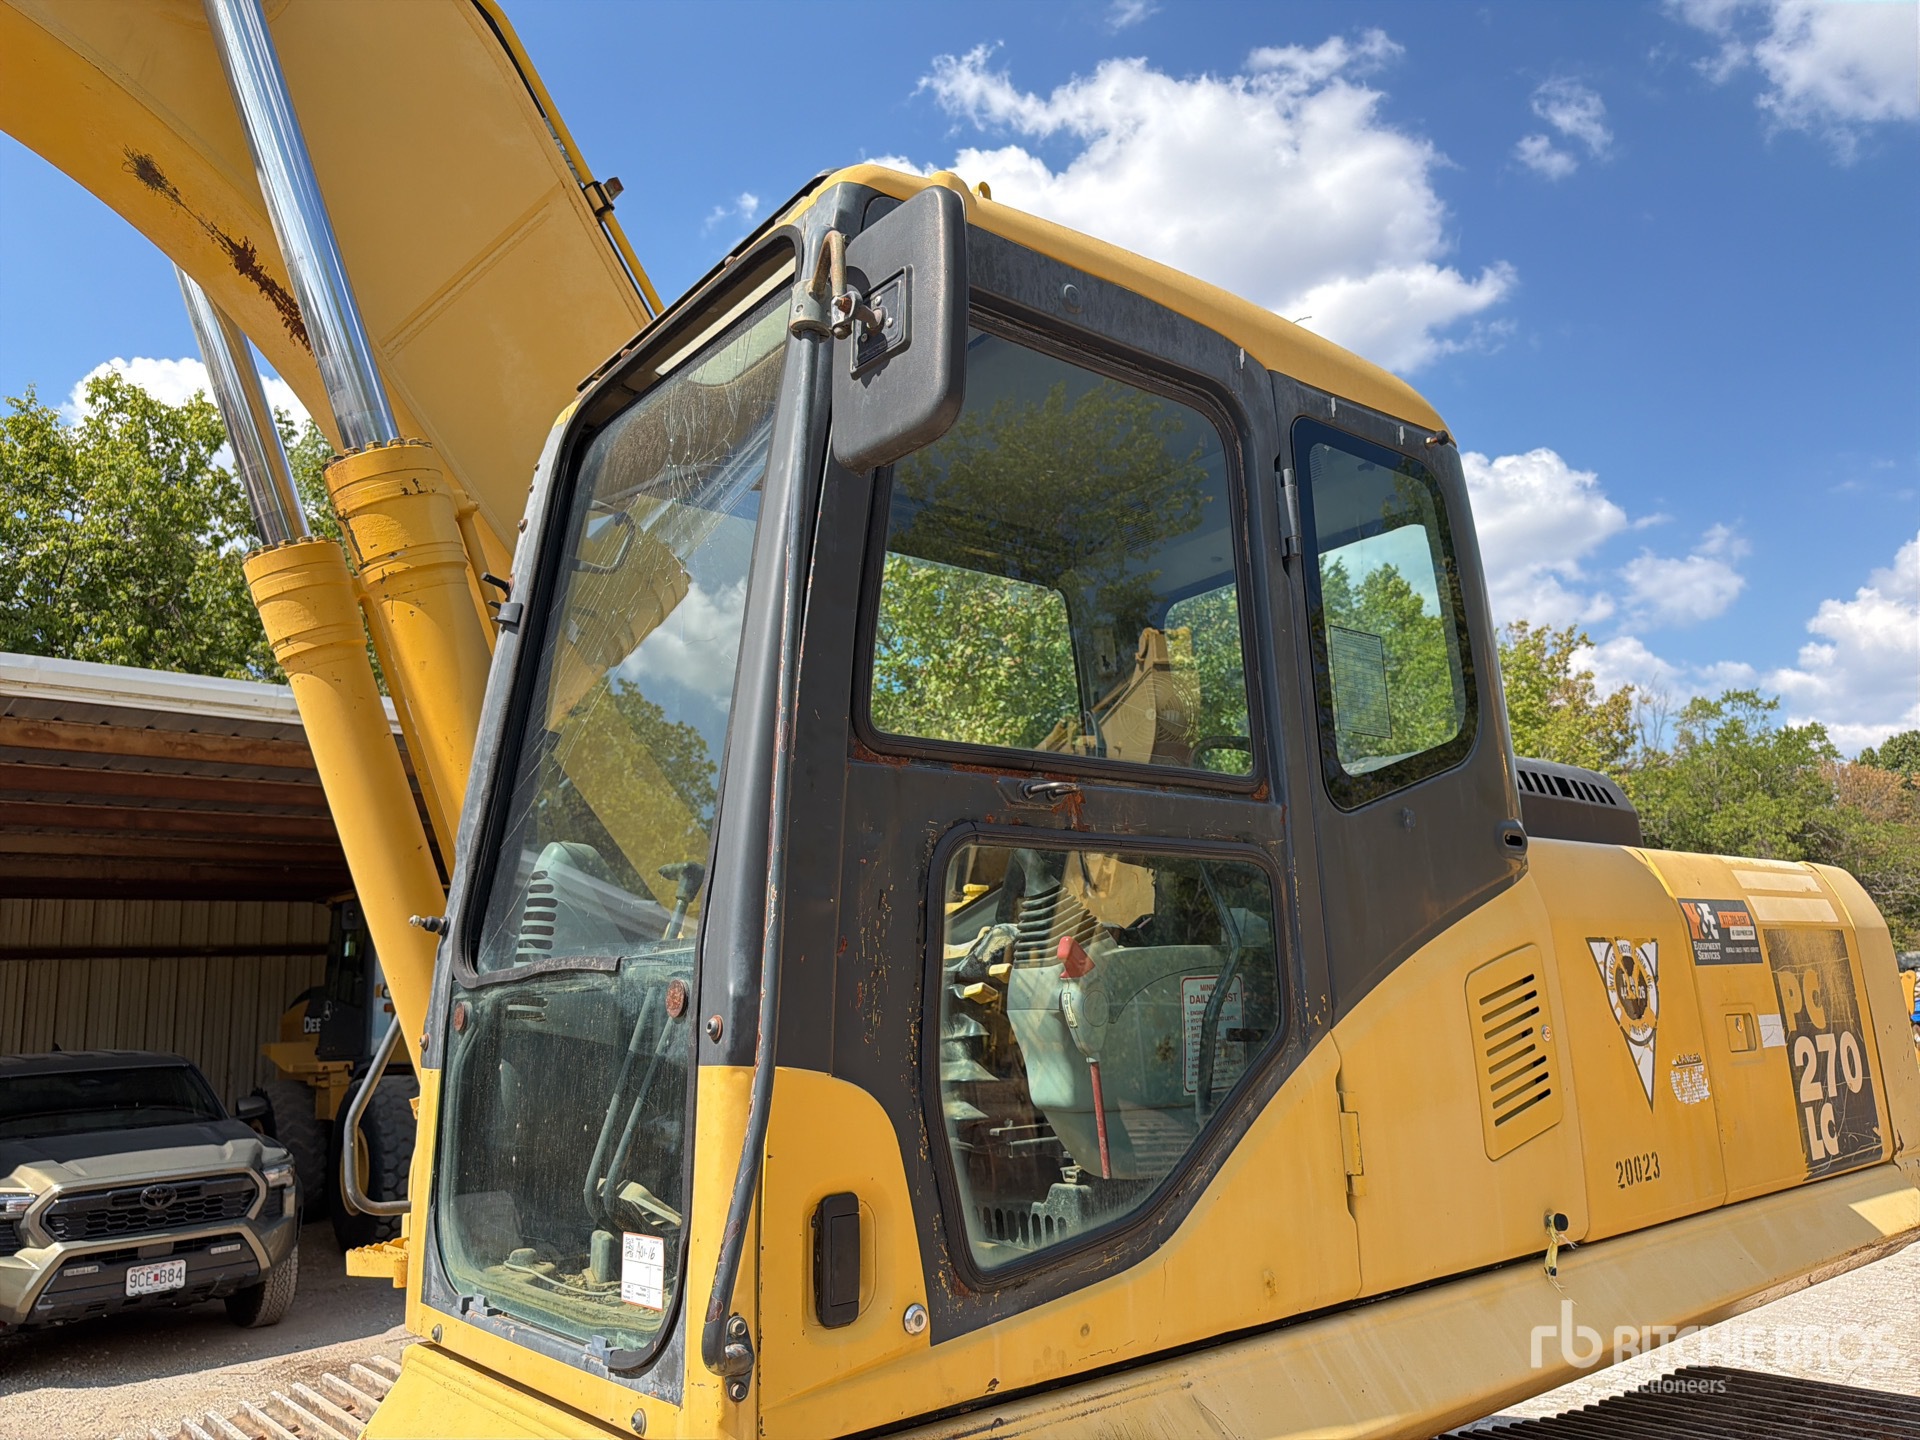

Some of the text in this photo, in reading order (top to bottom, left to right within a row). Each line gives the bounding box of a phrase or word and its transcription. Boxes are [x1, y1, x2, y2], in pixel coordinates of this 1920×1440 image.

[1693, 941, 1721, 951] EQUIPMENT
[1697, 951, 1721, 961] SERVICES
[1777, 969, 1827, 1032] PC
[304, 1016, 321, 1033] DEE
[1794, 1031, 1863, 1103] 270
[1805, 1102, 1840, 1161] LC
[1615, 1151, 1660, 1189] 20023
[129, 1270, 154, 1289] 9CE
[159, 1266, 183, 1285] B84
